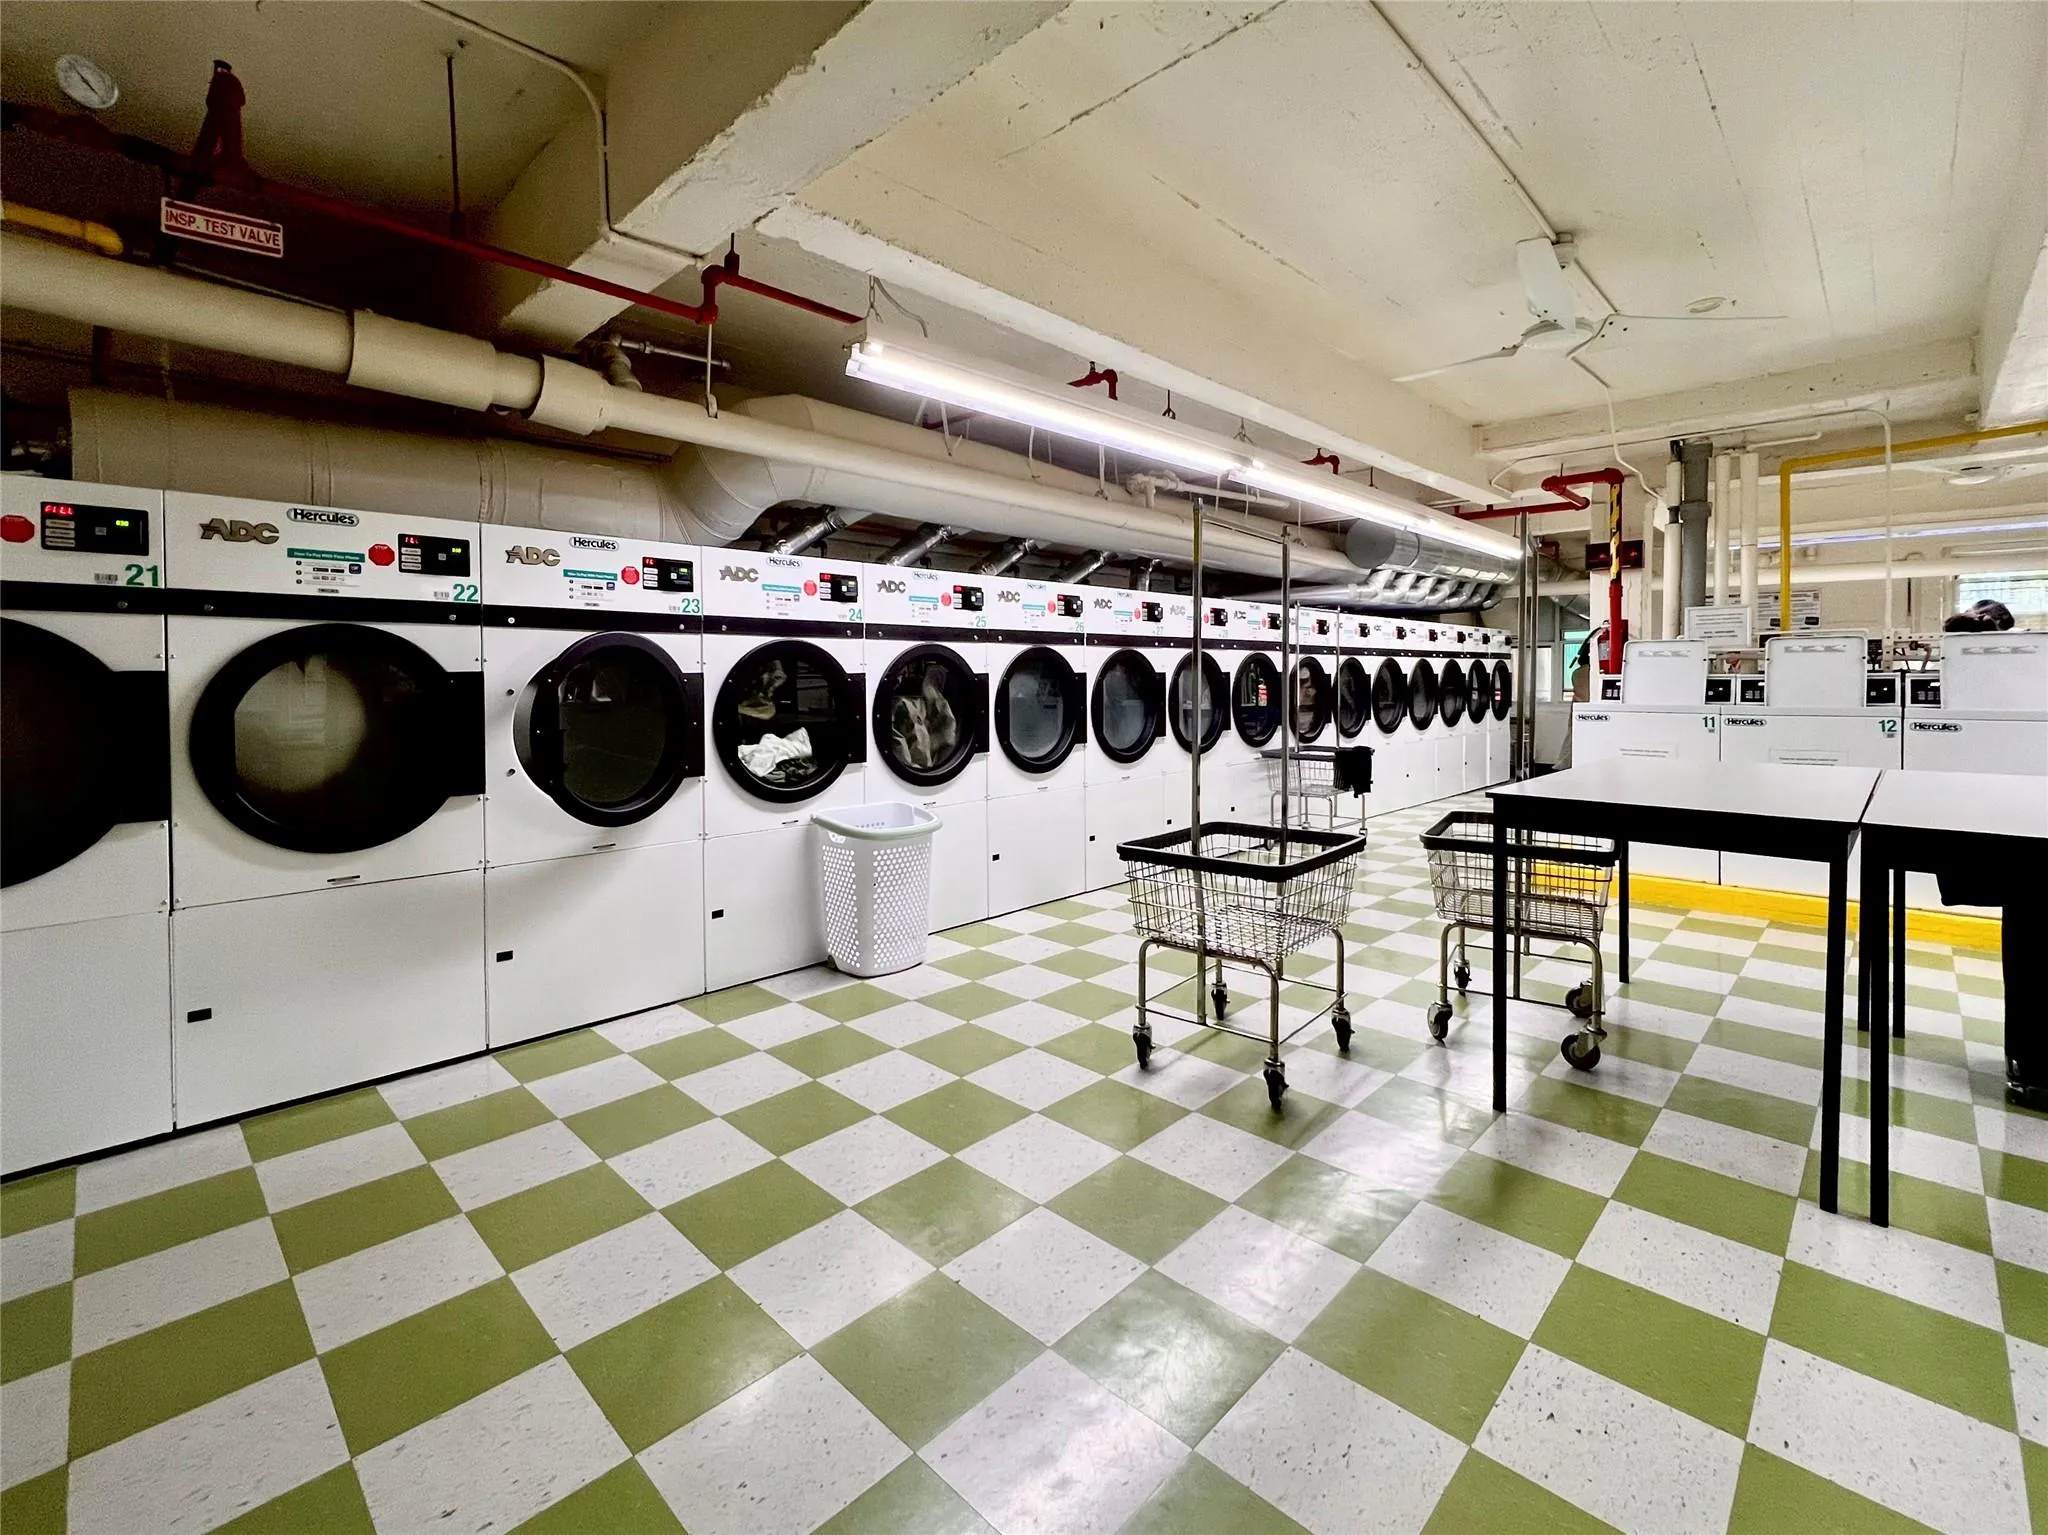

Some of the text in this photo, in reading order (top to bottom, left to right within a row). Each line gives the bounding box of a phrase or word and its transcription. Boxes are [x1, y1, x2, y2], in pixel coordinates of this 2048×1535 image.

[165, 209, 281, 246] INSP. TEST VALVE
[293, 508, 355, 525] Hercules
[199, 518, 280, 545] ADC
[573, 536, 617, 551] Hercules
[505, 545, 561, 567] ADC
[769, 556, 801, 567] Hercules
[125, 563, 159, 587] 21
[719, 565, 759, 583] ADC
[453, 584, 479, 602] 22
[877, 579, 906, 593] ADC
[996, 590, 1021, 603] ADC
[681, 597, 701, 614] 23
[1093, 598, 1113, 610] ADC
[849, 608, 863, 622] 24
[975, 615, 987, 628] 25
[1075, 621, 1085, 632] 26
[1578, 714, 1609, 722] Hercules
[1703, 716, 1716, 728] 11
[1727, 718, 1765, 727] Hercules
[1879, 719, 1897, 732] 12
[1913, 722, 1959, 732] Hercules
